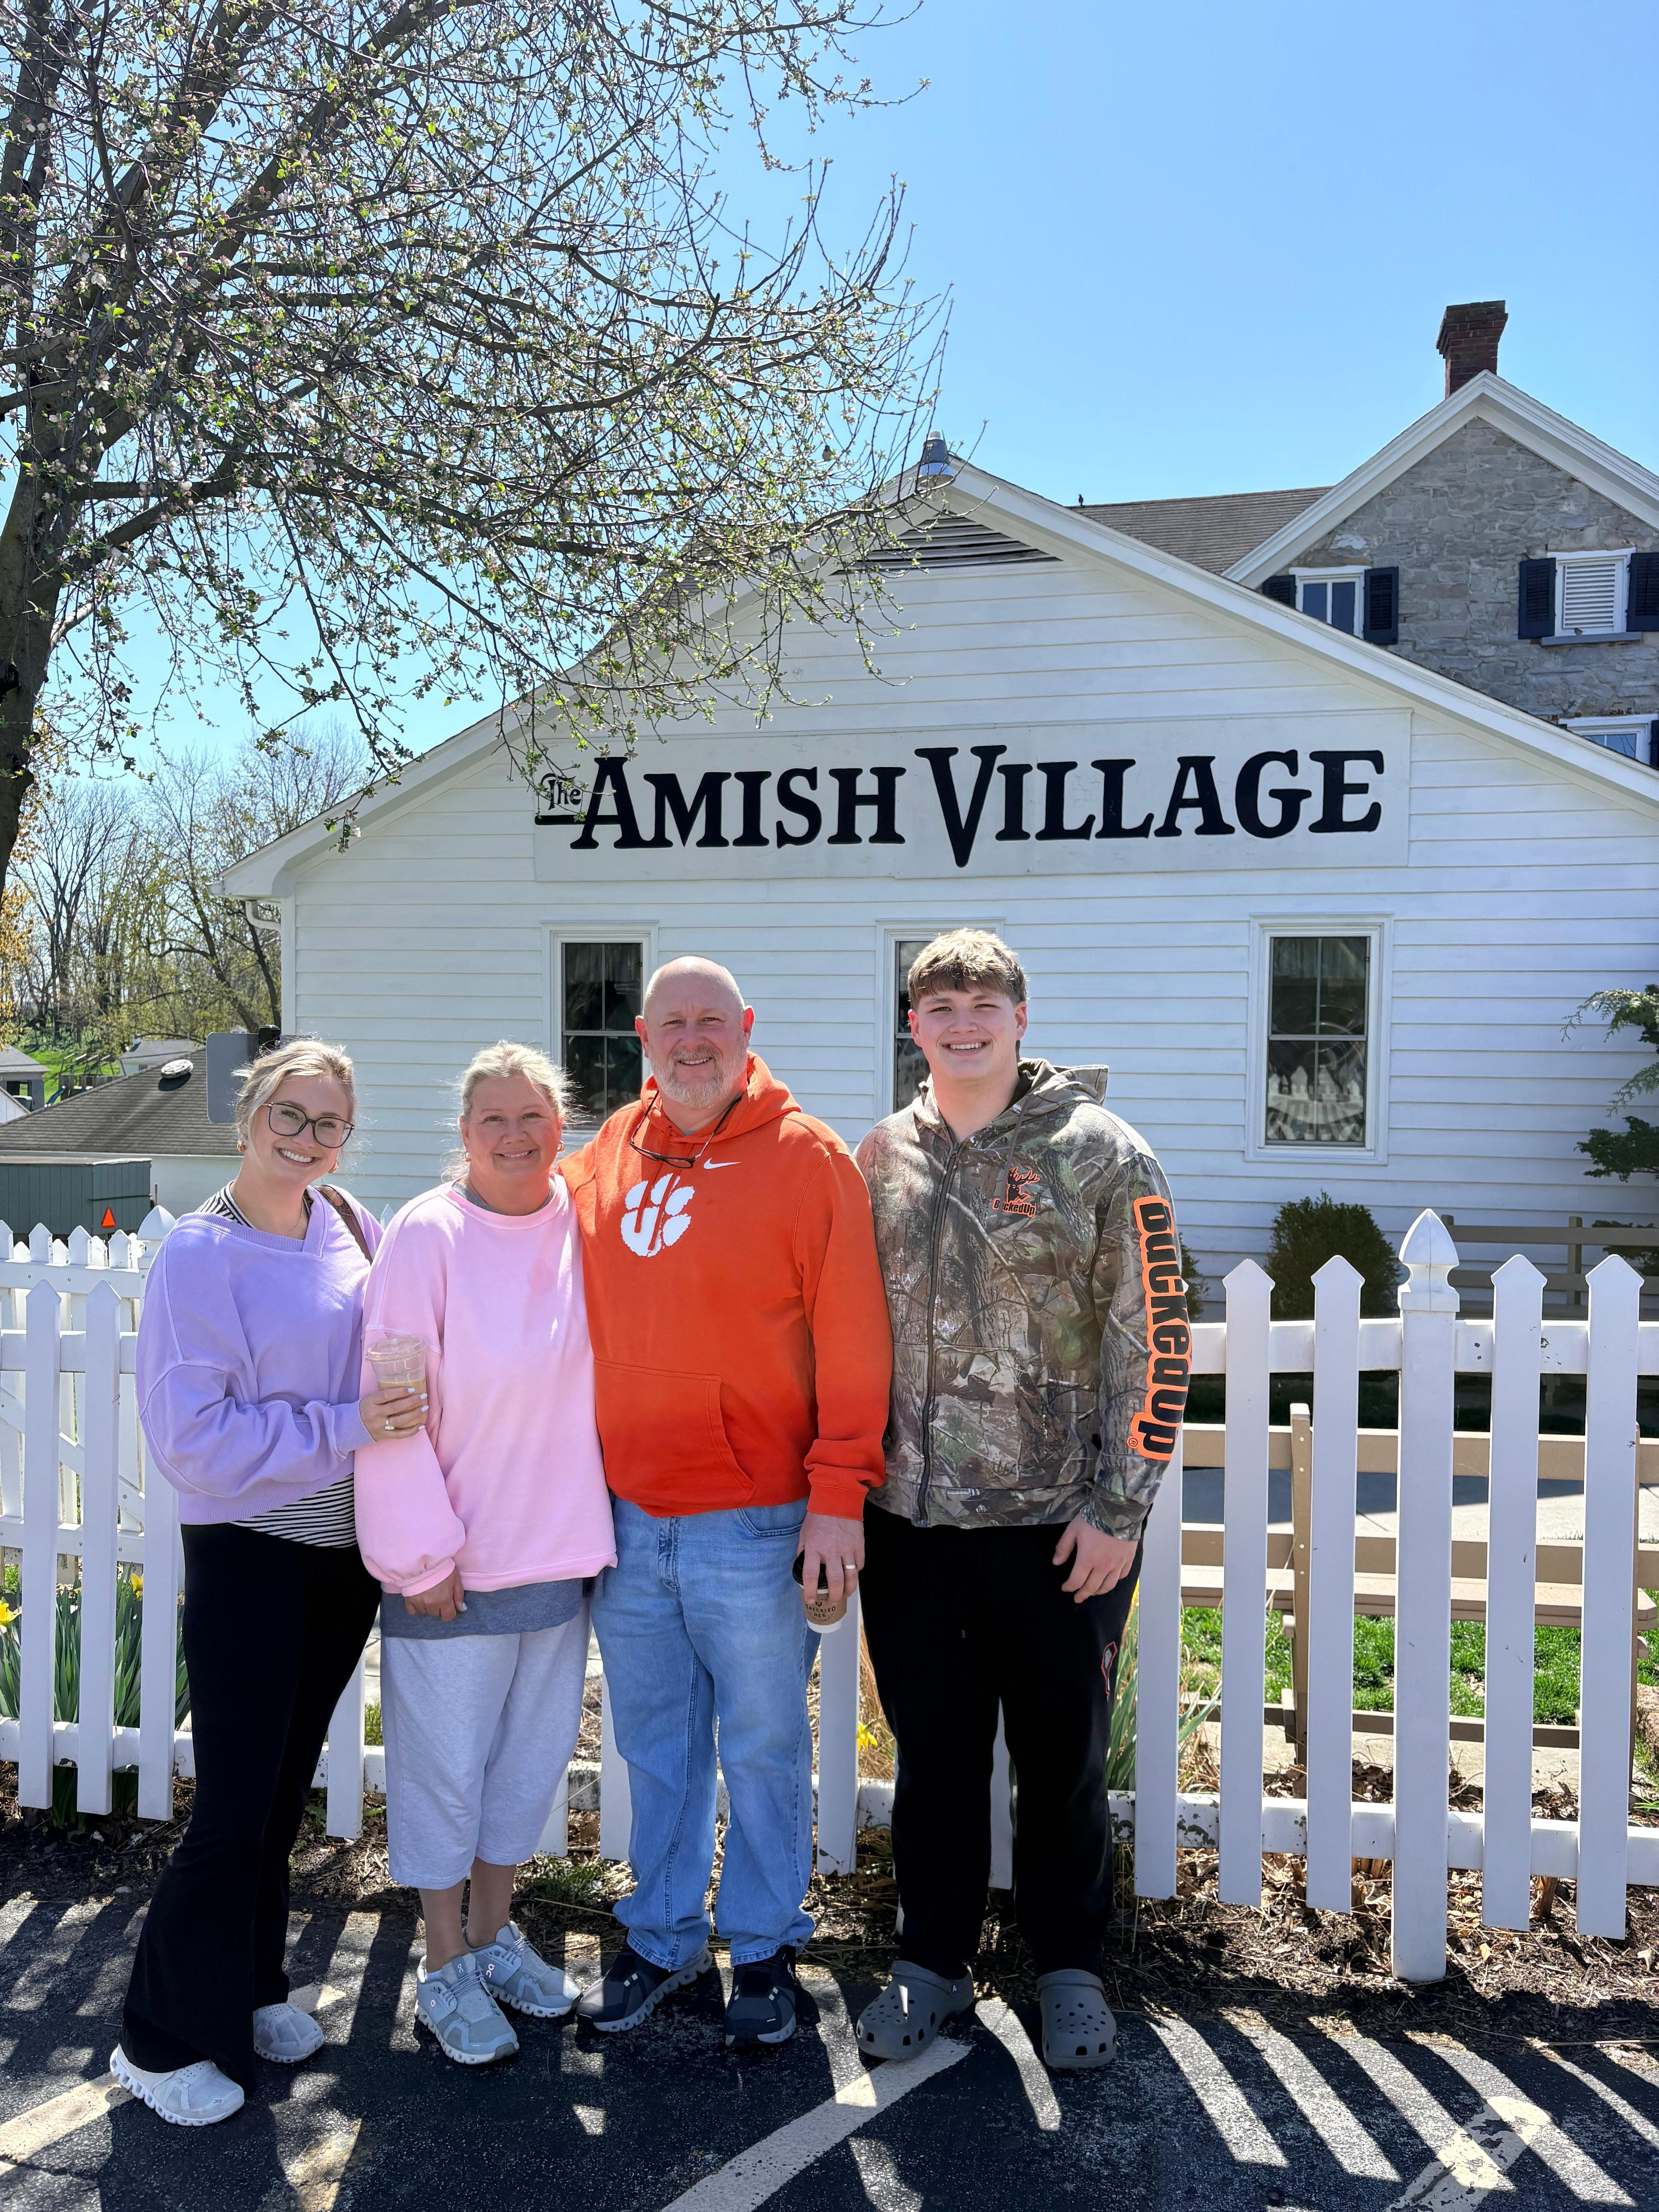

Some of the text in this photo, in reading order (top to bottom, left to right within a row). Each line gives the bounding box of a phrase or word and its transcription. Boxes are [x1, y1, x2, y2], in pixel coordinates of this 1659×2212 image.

[535, 745, 1384, 868] The AMISH VILLAGE
[993, 1200, 1035, 1216] BckedUp
